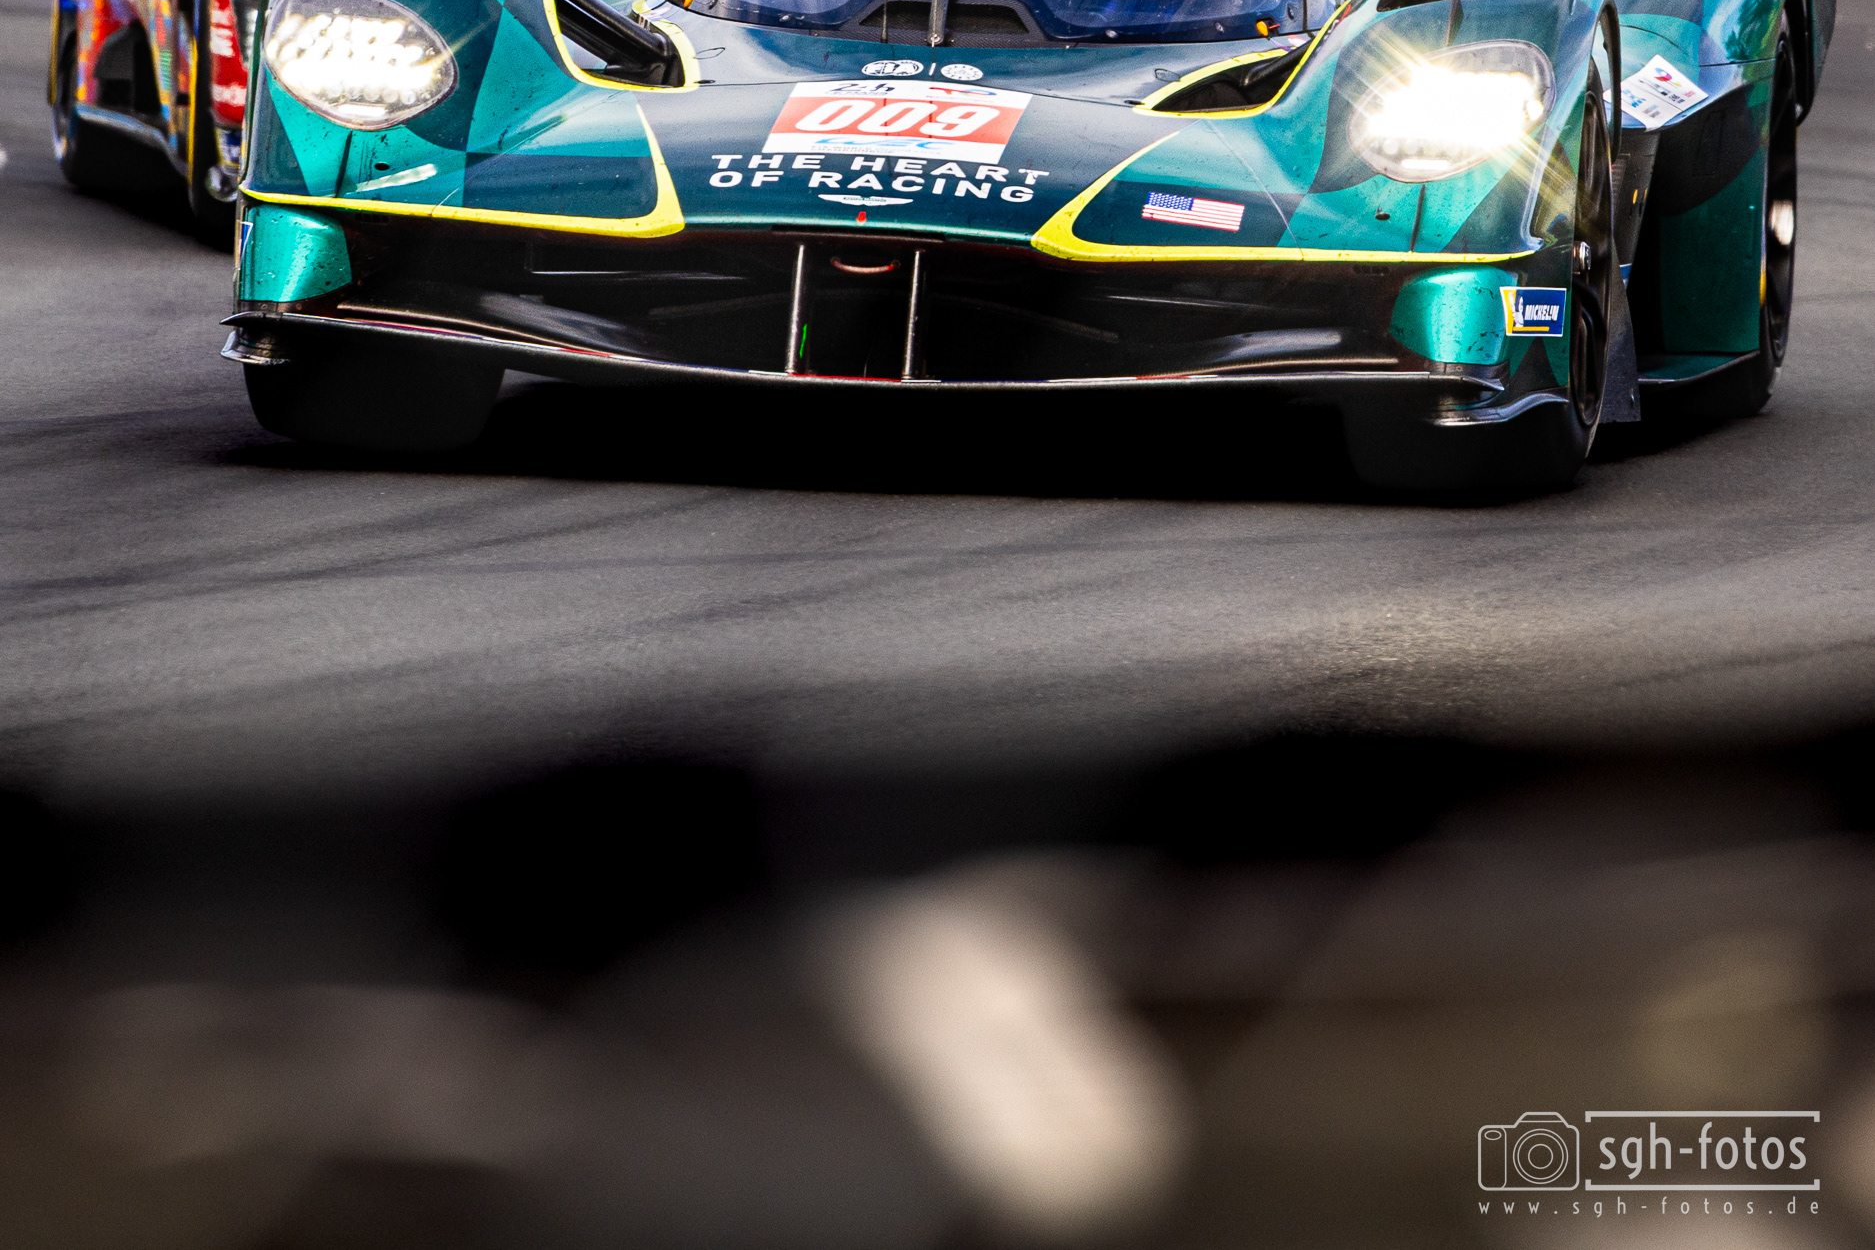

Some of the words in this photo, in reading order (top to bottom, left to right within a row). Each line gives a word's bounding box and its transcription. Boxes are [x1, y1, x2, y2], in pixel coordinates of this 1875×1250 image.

[795, 99, 1001, 137] 009
[711, 154, 826, 169] THE
[850, 156, 1050, 185] HEART
[709, 171, 784, 188] OF
[808, 171, 1034, 203] RACING
